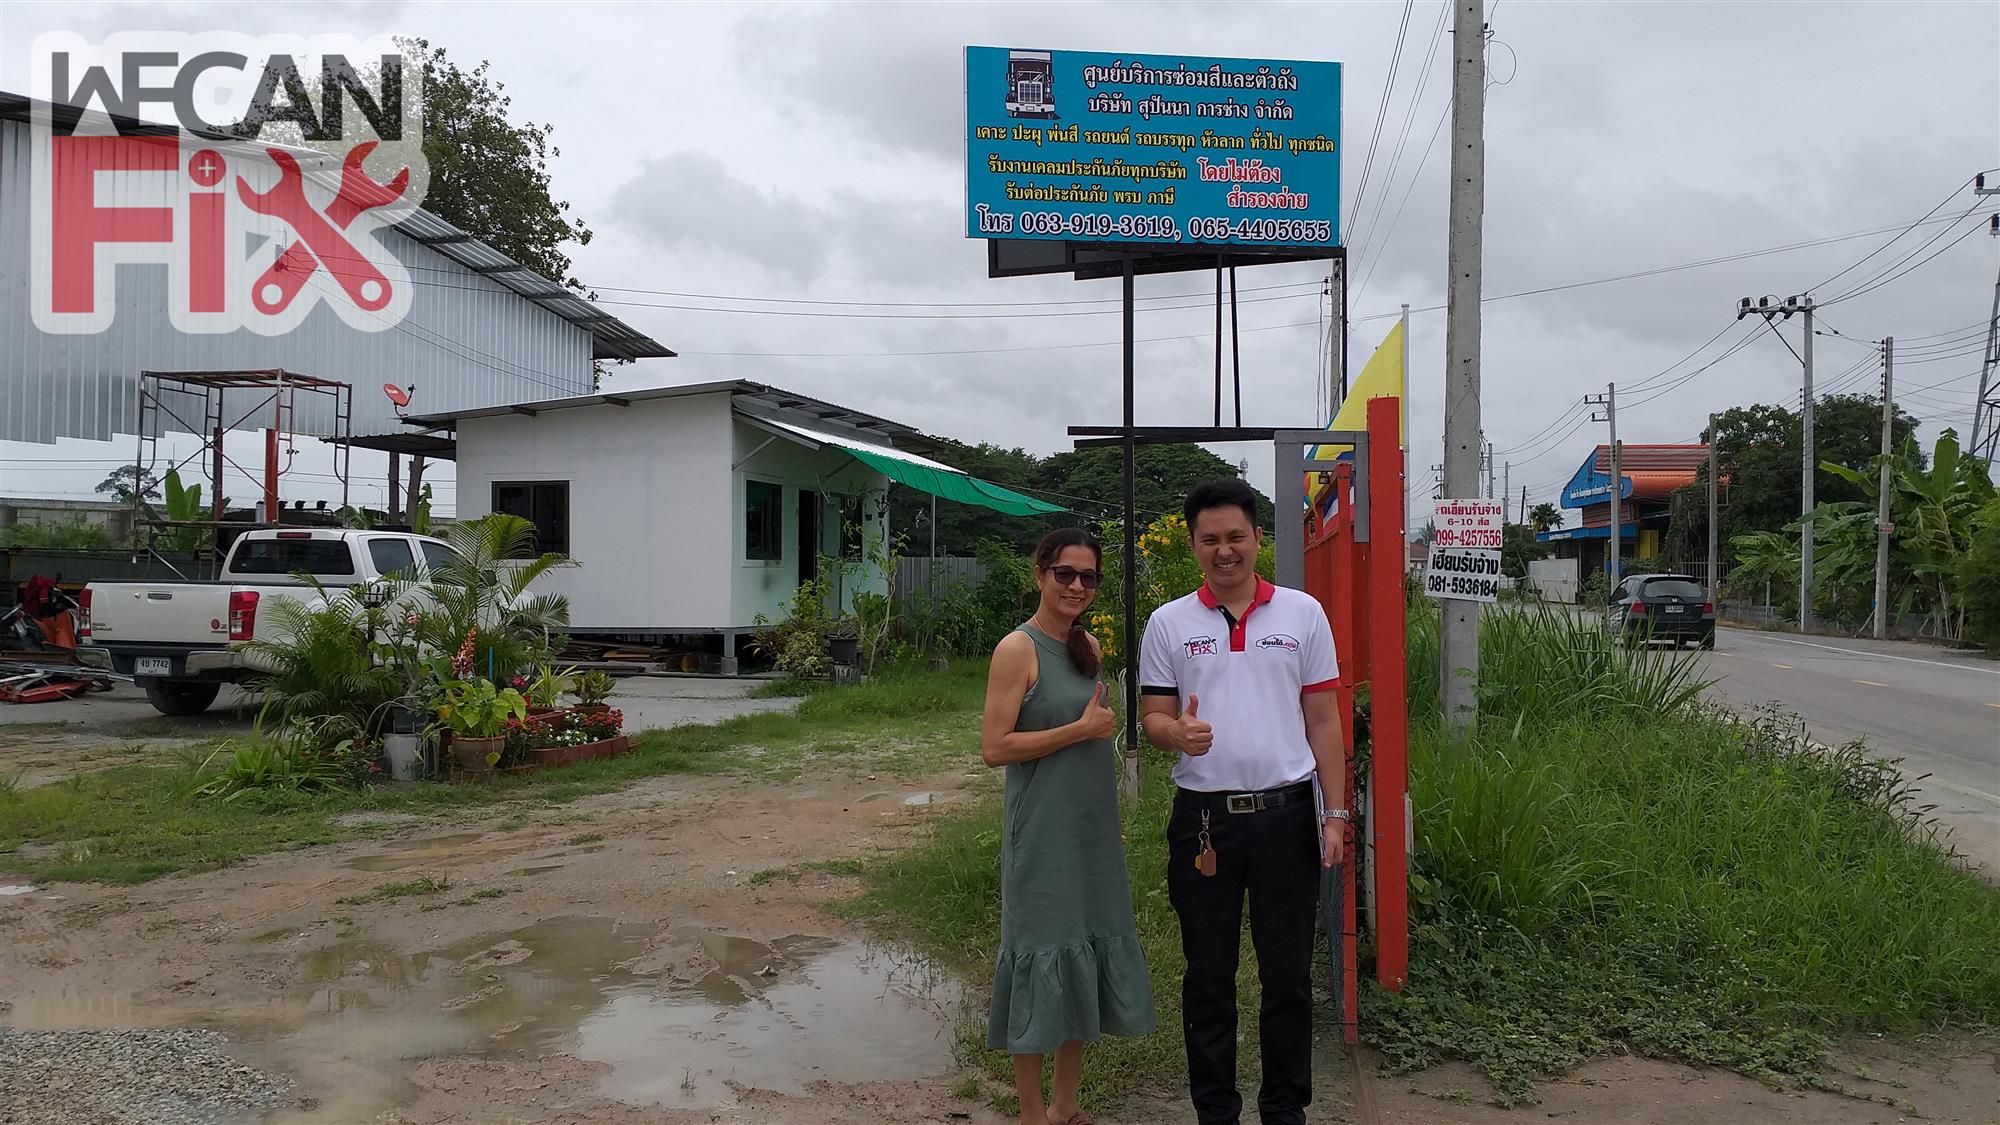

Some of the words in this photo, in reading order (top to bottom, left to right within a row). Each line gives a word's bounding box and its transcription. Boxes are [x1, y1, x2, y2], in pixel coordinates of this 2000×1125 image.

[1083, 61, 1298, 90] ศูนย์บริการซ่อมสีและตัวถัง
[1088, 93, 1132, 114] บริษัท
[1138, 95, 1190, 119] สุปันนา
[1197, 99, 1249, 118] การช่าง
[1254, 100, 1293, 119] จำกัด
[976, 126, 1007, 140] เคาะ
[1012, 125, 1042, 145] ปะผุ
[1048, 124, 1078, 142] พ่นสี
[1084, 127, 1130, 144] รถยนต์
[1136, 133, 1195, 151] รถบรรทุก
[1201, 130, 1244, 149] หัวลาก
[1250, 127, 1283, 150] ทั่วไป
[1288, 135, 1334, 155] ทุกชนิด
[988, 155, 1187, 182] รับงานเคลมประกันภัยทุกบริษัท
[1197, 157, 1280, 183] โดยไม่ต้อง
[1006, 182, 1108, 202] รับต่อประกันภัย
[1114, 191, 1141, 204] พรบ
[1147, 187, 1175, 205] ภาษี
[1227, 185, 1308, 209] สำรองจ่าย
[976, 204, 1013, 232] โทร
[1020, 212, 1182, 240] 063-919-3619,
[1189, 218, 1332, 241] 065-4405655
[1447, 518, 1473, 526] 6-10
[1435, 529, 1501, 546] 099-4257556
[1428, 575, 1498, 597] 081-5936184
[152, 659, 169, 668] 7742
